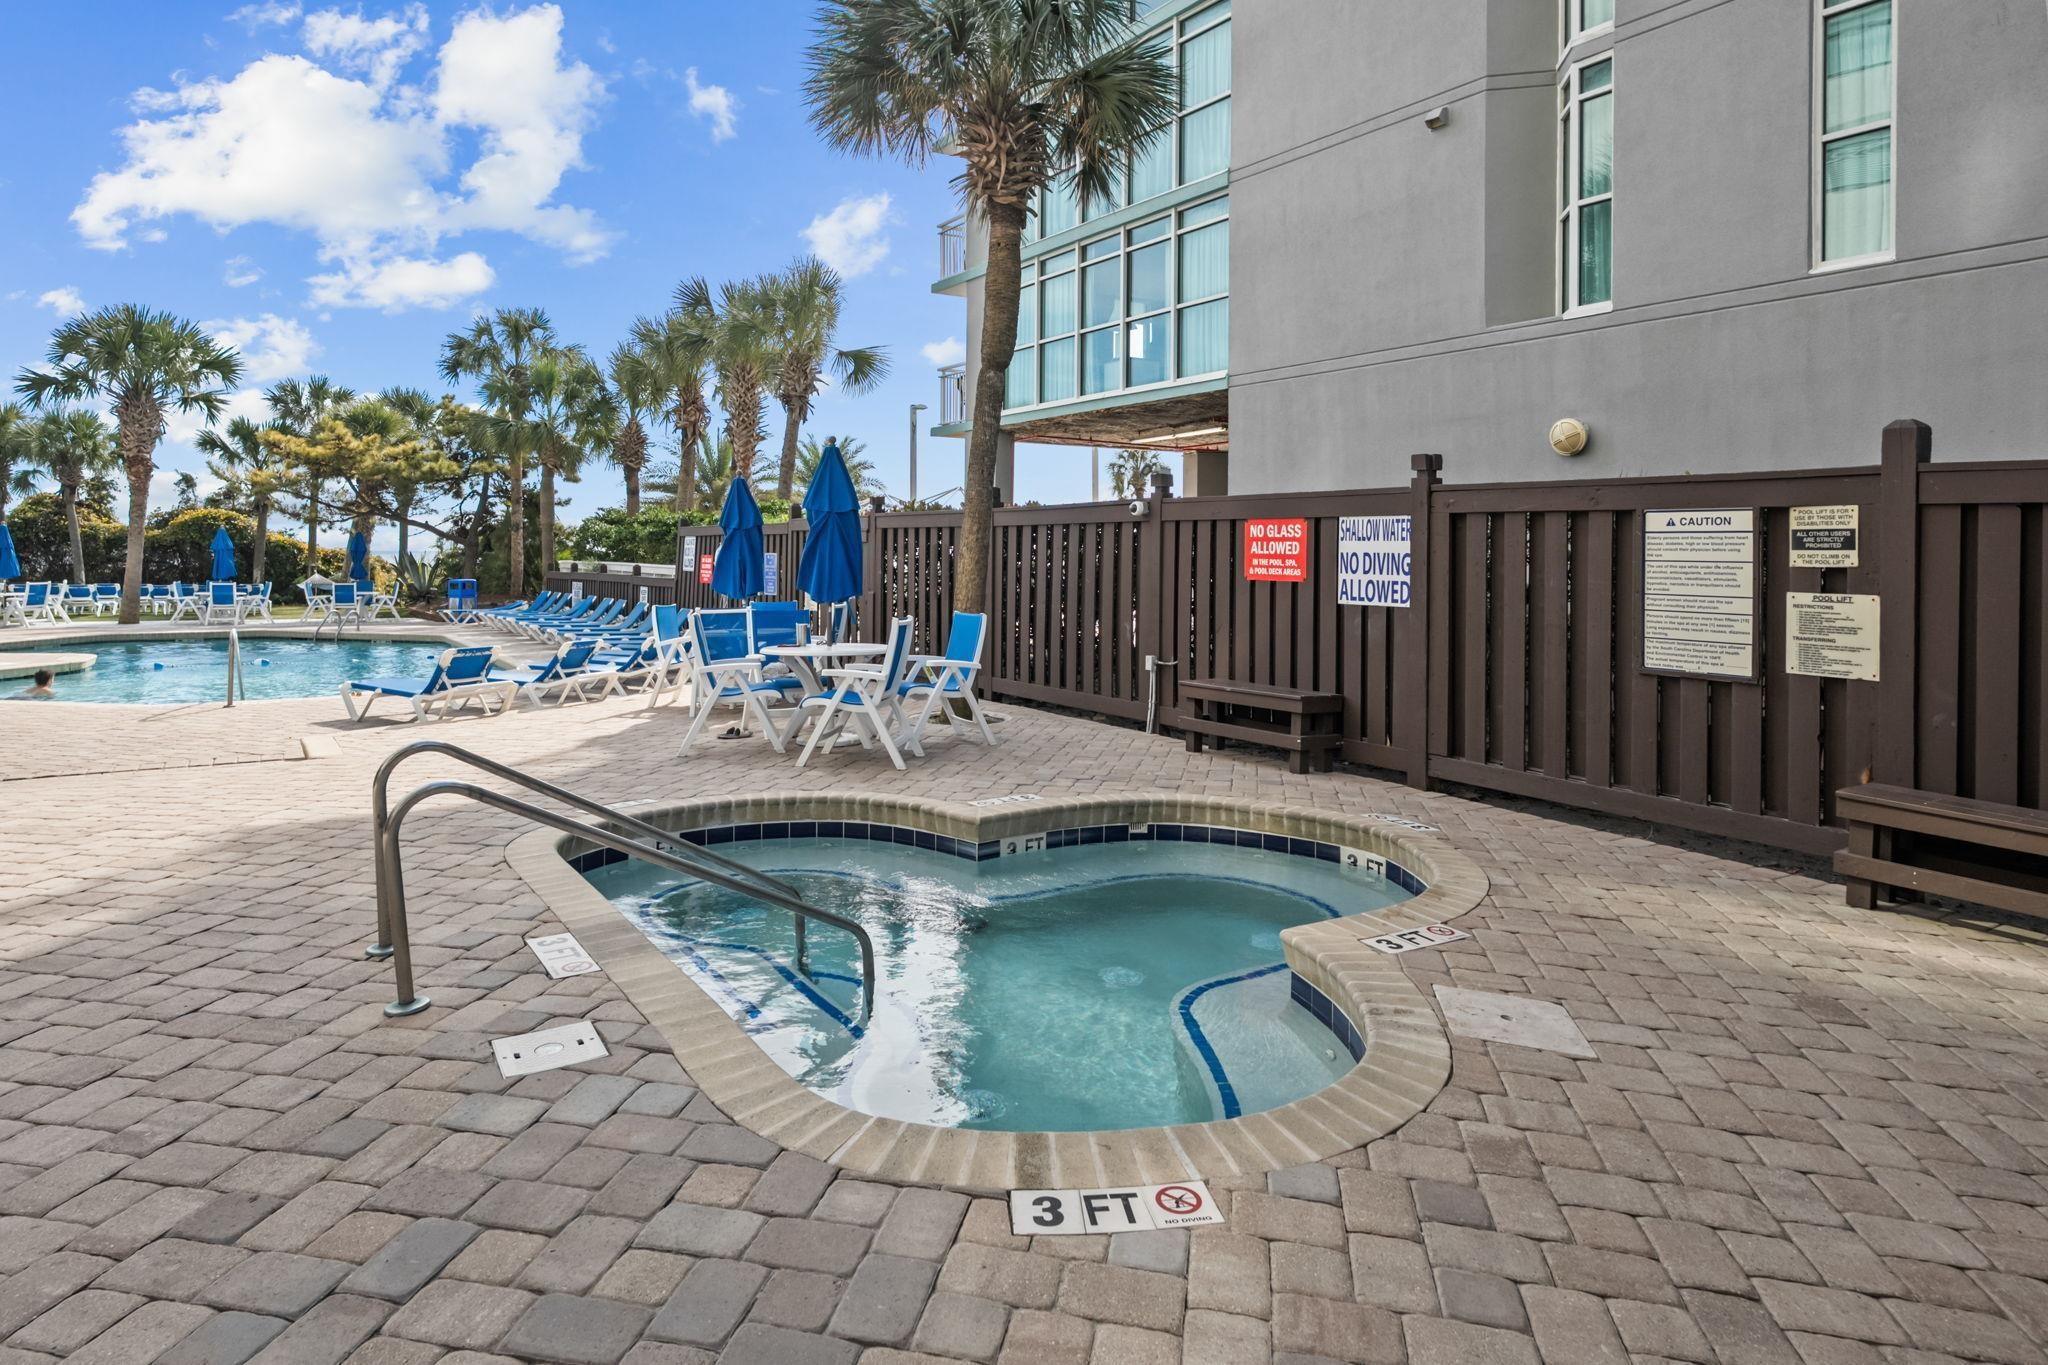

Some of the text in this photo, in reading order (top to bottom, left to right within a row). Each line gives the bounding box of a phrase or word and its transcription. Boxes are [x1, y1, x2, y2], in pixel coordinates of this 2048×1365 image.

[1341, 518, 1411, 541] SHALLOW WATER
[1680, 517, 1731, 525] CAUTION
[1250, 524, 1302, 538] NO GLASS
[1251, 542, 1300, 554] ALLOWED
[1340, 552, 1411, 576] NO DIVING
[1340, 579, 1410, 604] ALLOWED
[1007, 837, 1044, 854] 3 FT
[1347, 854, 1383, 874] 3 FT
[537, 937, 568, 946] 3
[1376, 938, 1403, 949] 3
[1396, 930, 1435, 945] FT
[1032, 1192, 1138, 1226] 3 FT
